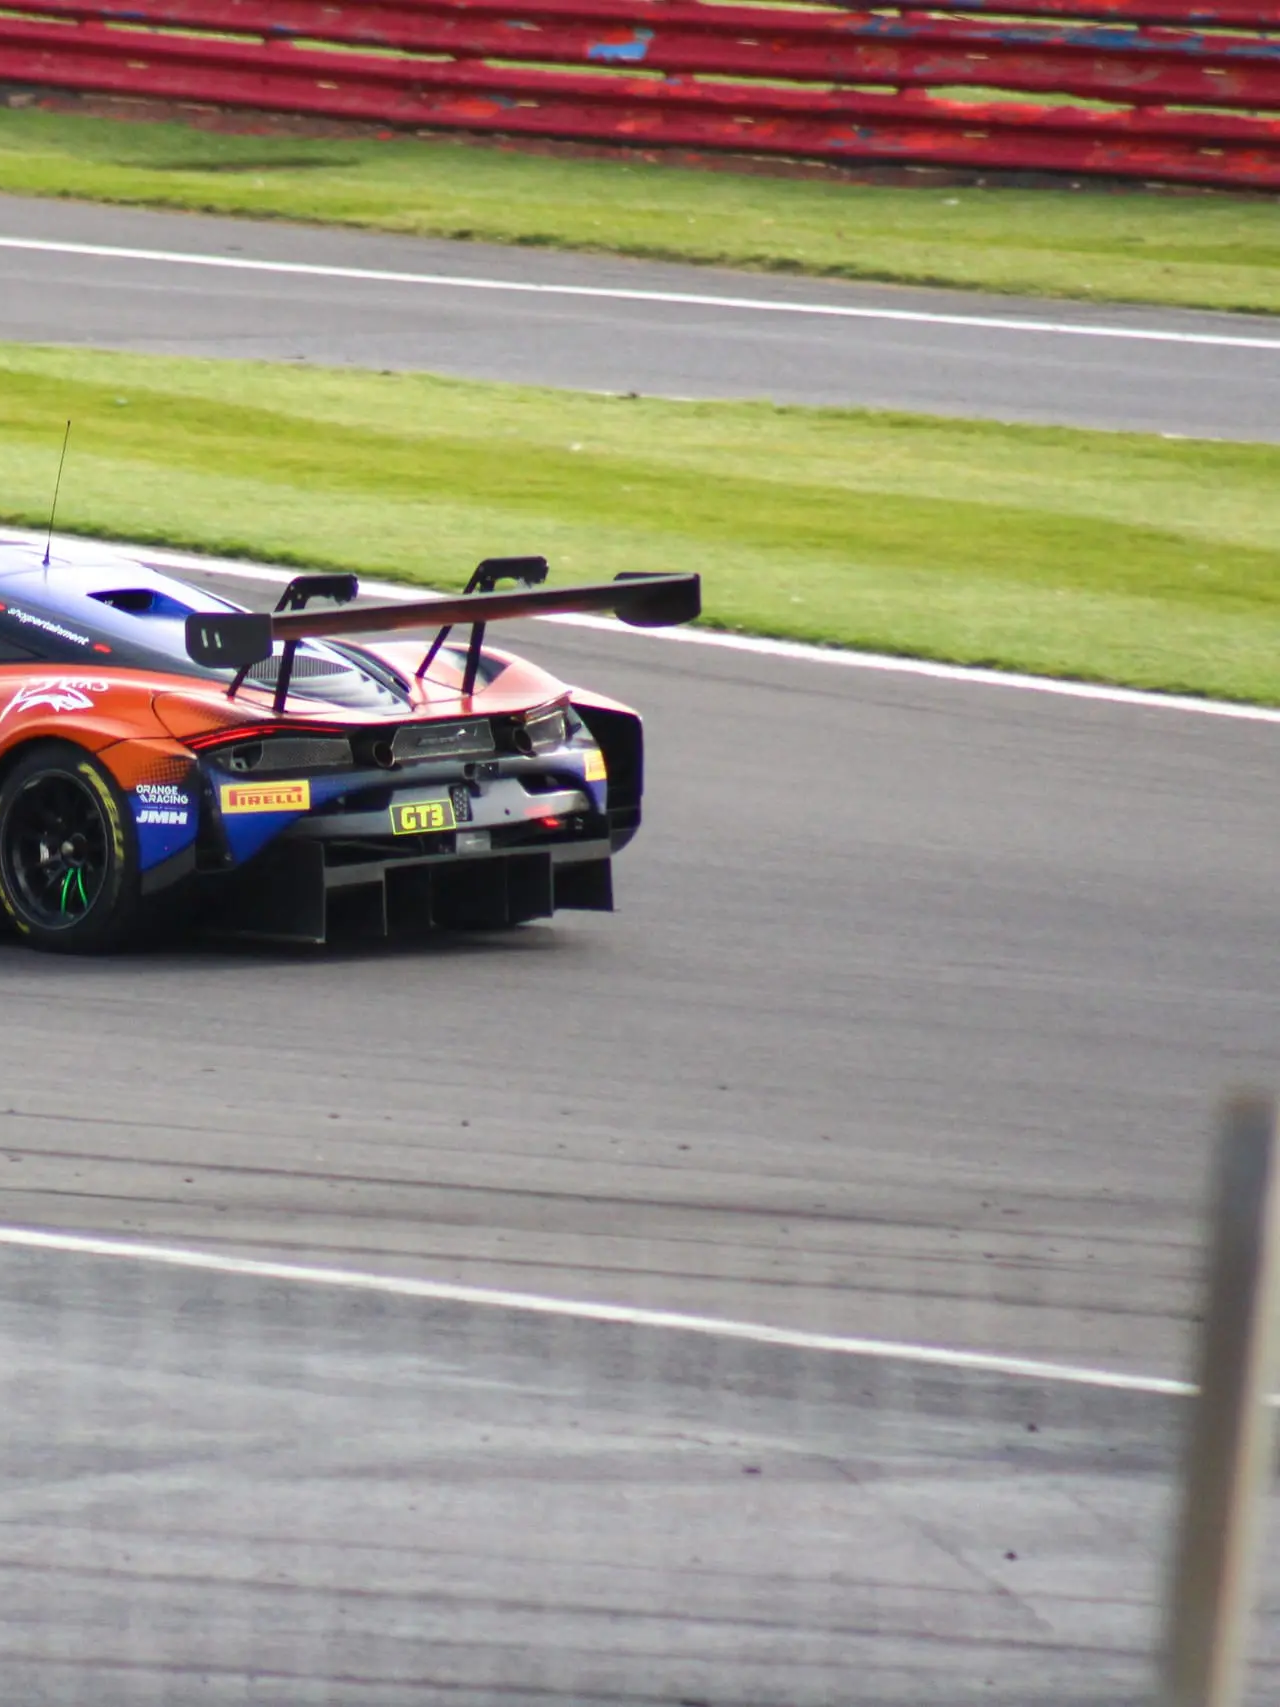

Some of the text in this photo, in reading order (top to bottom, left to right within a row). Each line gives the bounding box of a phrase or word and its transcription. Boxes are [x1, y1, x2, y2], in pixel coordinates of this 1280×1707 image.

[136, 784, 178, 795] ORANGE
[229, 786, 303, 807] PIRELLI
[149, 794, 189, 804] RACING
[136, 809, 188, 825] JMH
[400, 804, 444, 831] GT3
